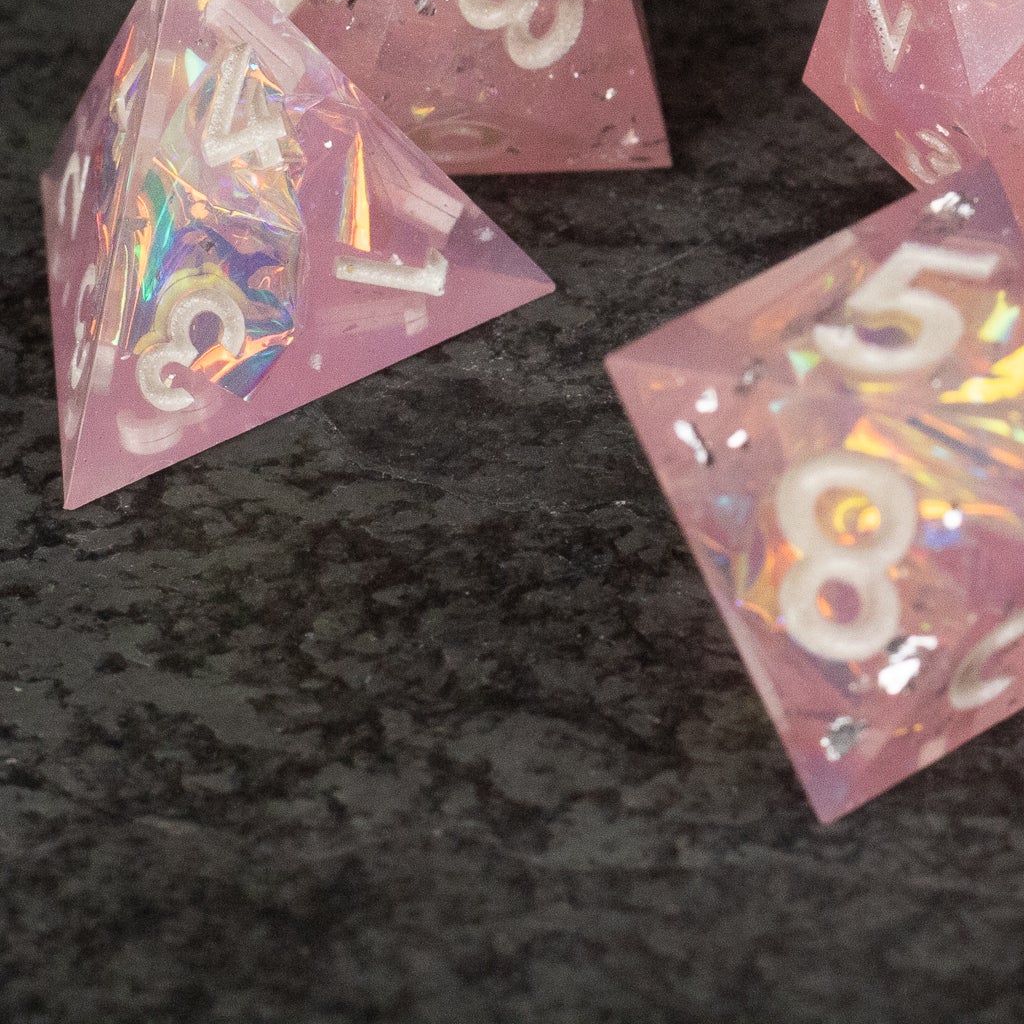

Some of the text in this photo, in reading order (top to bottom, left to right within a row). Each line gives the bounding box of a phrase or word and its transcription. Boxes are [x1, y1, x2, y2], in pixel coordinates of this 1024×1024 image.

[201, 42, 290, 168] 4
[334, 248, 447, 297] 1
[813, 242, 998, 372] 5
[135, 288, 246, 413] 3
[776, 454, 918, 663] 8
